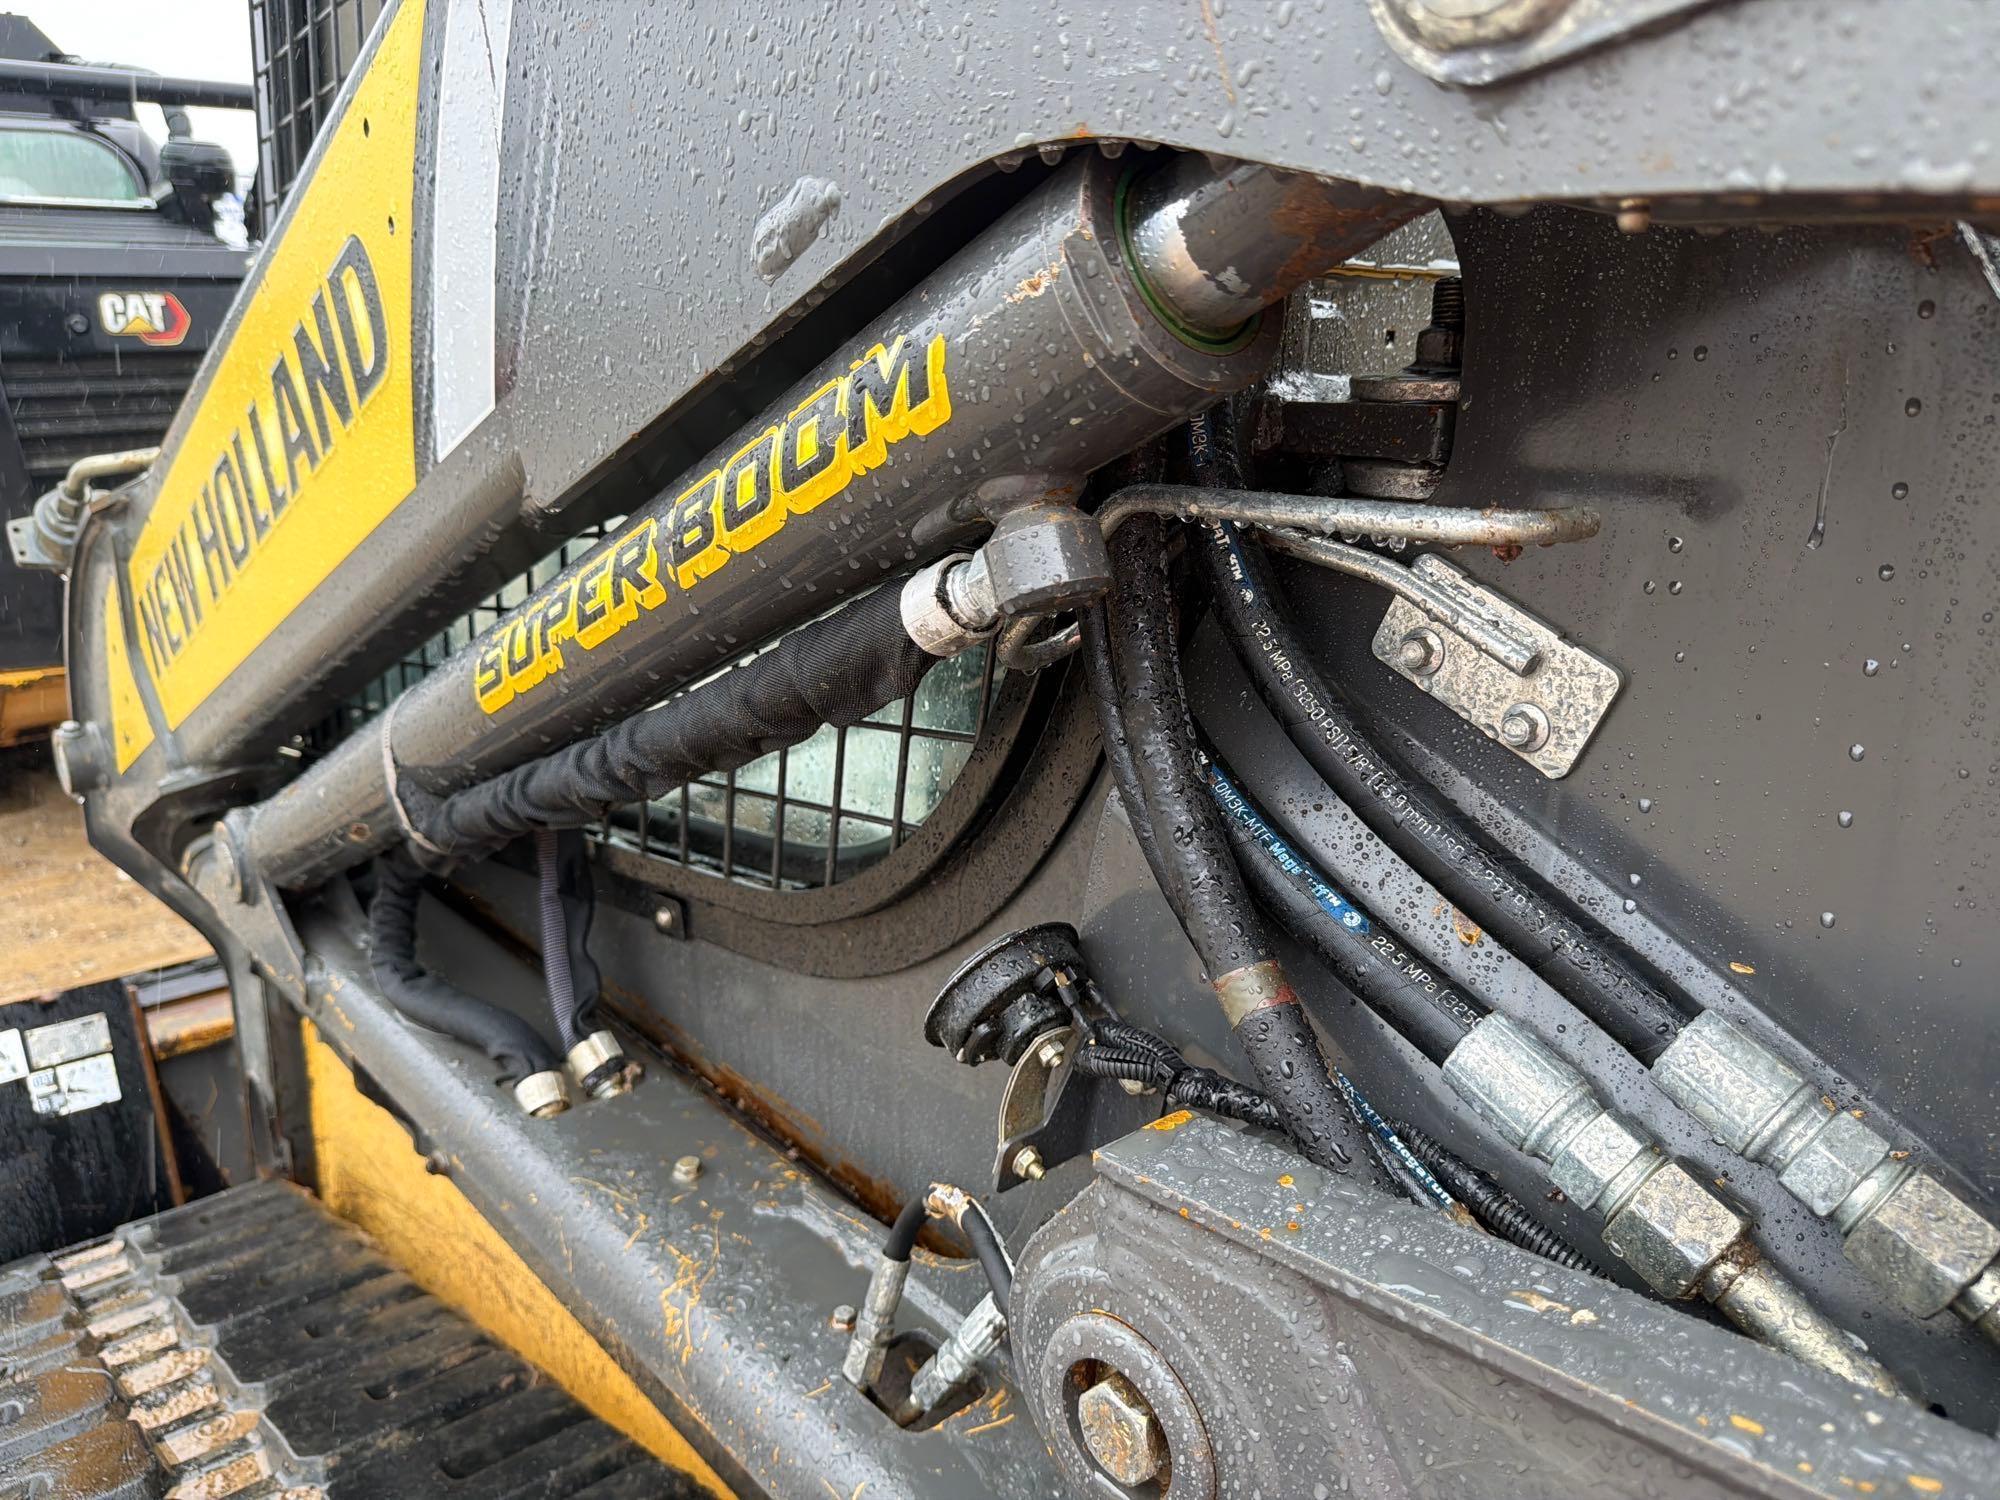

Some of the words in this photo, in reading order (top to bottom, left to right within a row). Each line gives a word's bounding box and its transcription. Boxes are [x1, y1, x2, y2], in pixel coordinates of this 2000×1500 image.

[100, 293, 167, 333] CAT
[139, 522, 203, 677] NEW
[190, 234, 391, 603] HOLLAND
[473, 518, 667, 714] SUPER
[667, 333, 952, 590] BOOM
[1269, 649, 1294, 682] MPa
[1371, 936, 1408, 966] 22.5
[1403, 962, 1437, 992] MPa
